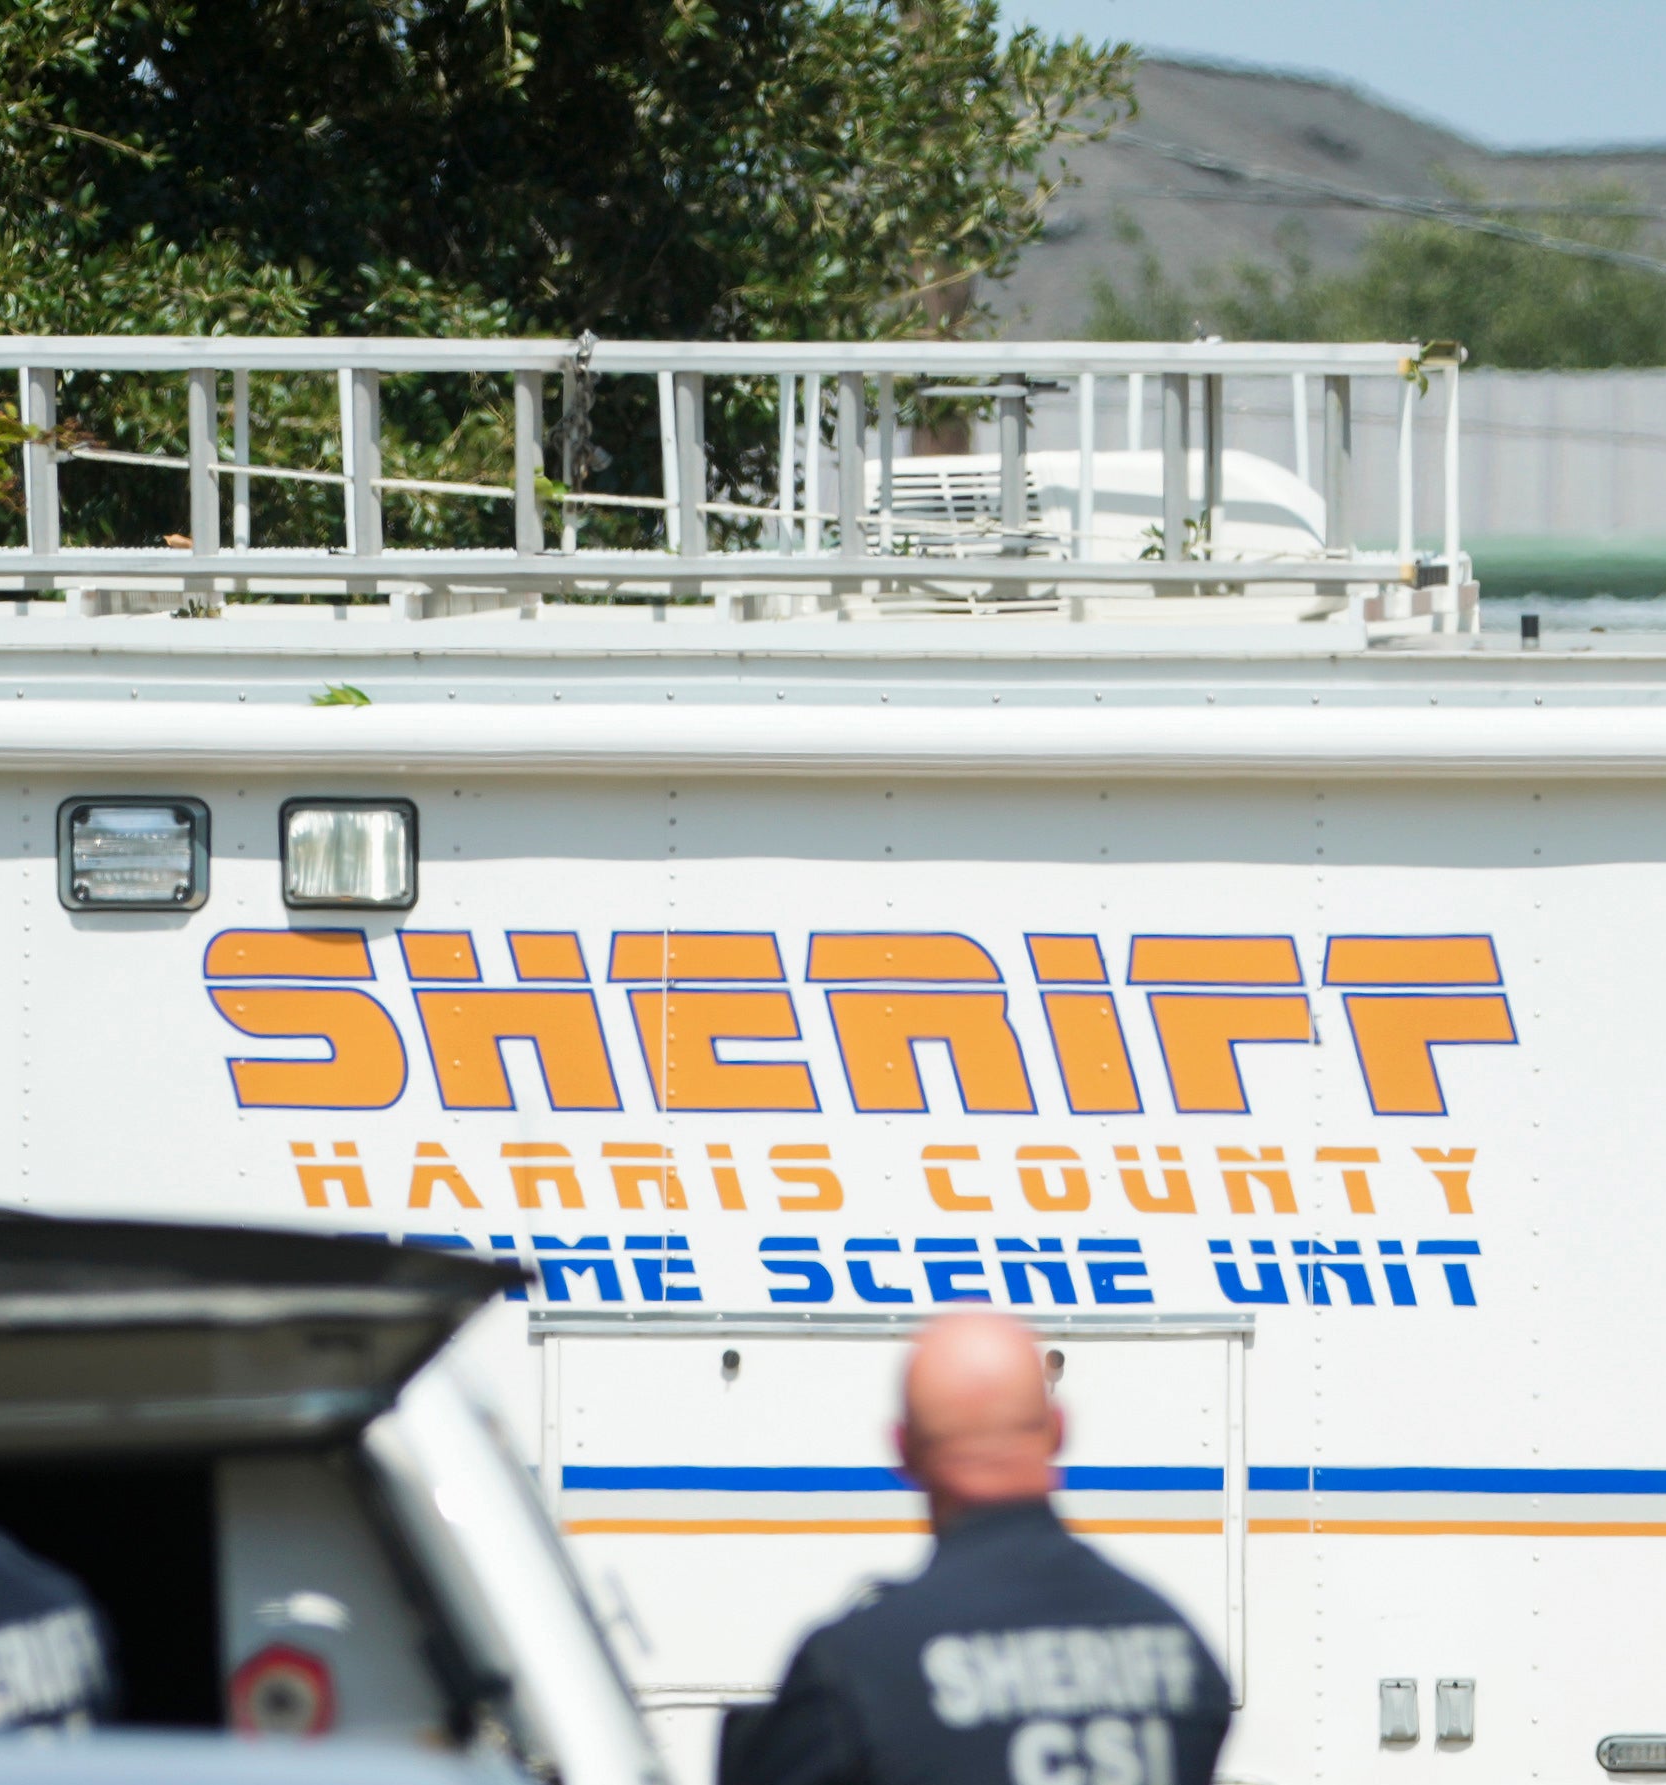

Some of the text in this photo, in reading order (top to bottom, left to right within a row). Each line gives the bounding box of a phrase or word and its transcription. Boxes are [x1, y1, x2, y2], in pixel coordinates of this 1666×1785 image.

[203, 927, 1519, 1117] SHERIFF
[290, 1142, 1477, 1215] HARRIS COUNTY
[338, 1233, 1482, 1307] IME SCENE UNIT
[921, 1624, 1197, 1728] SHERIFF
